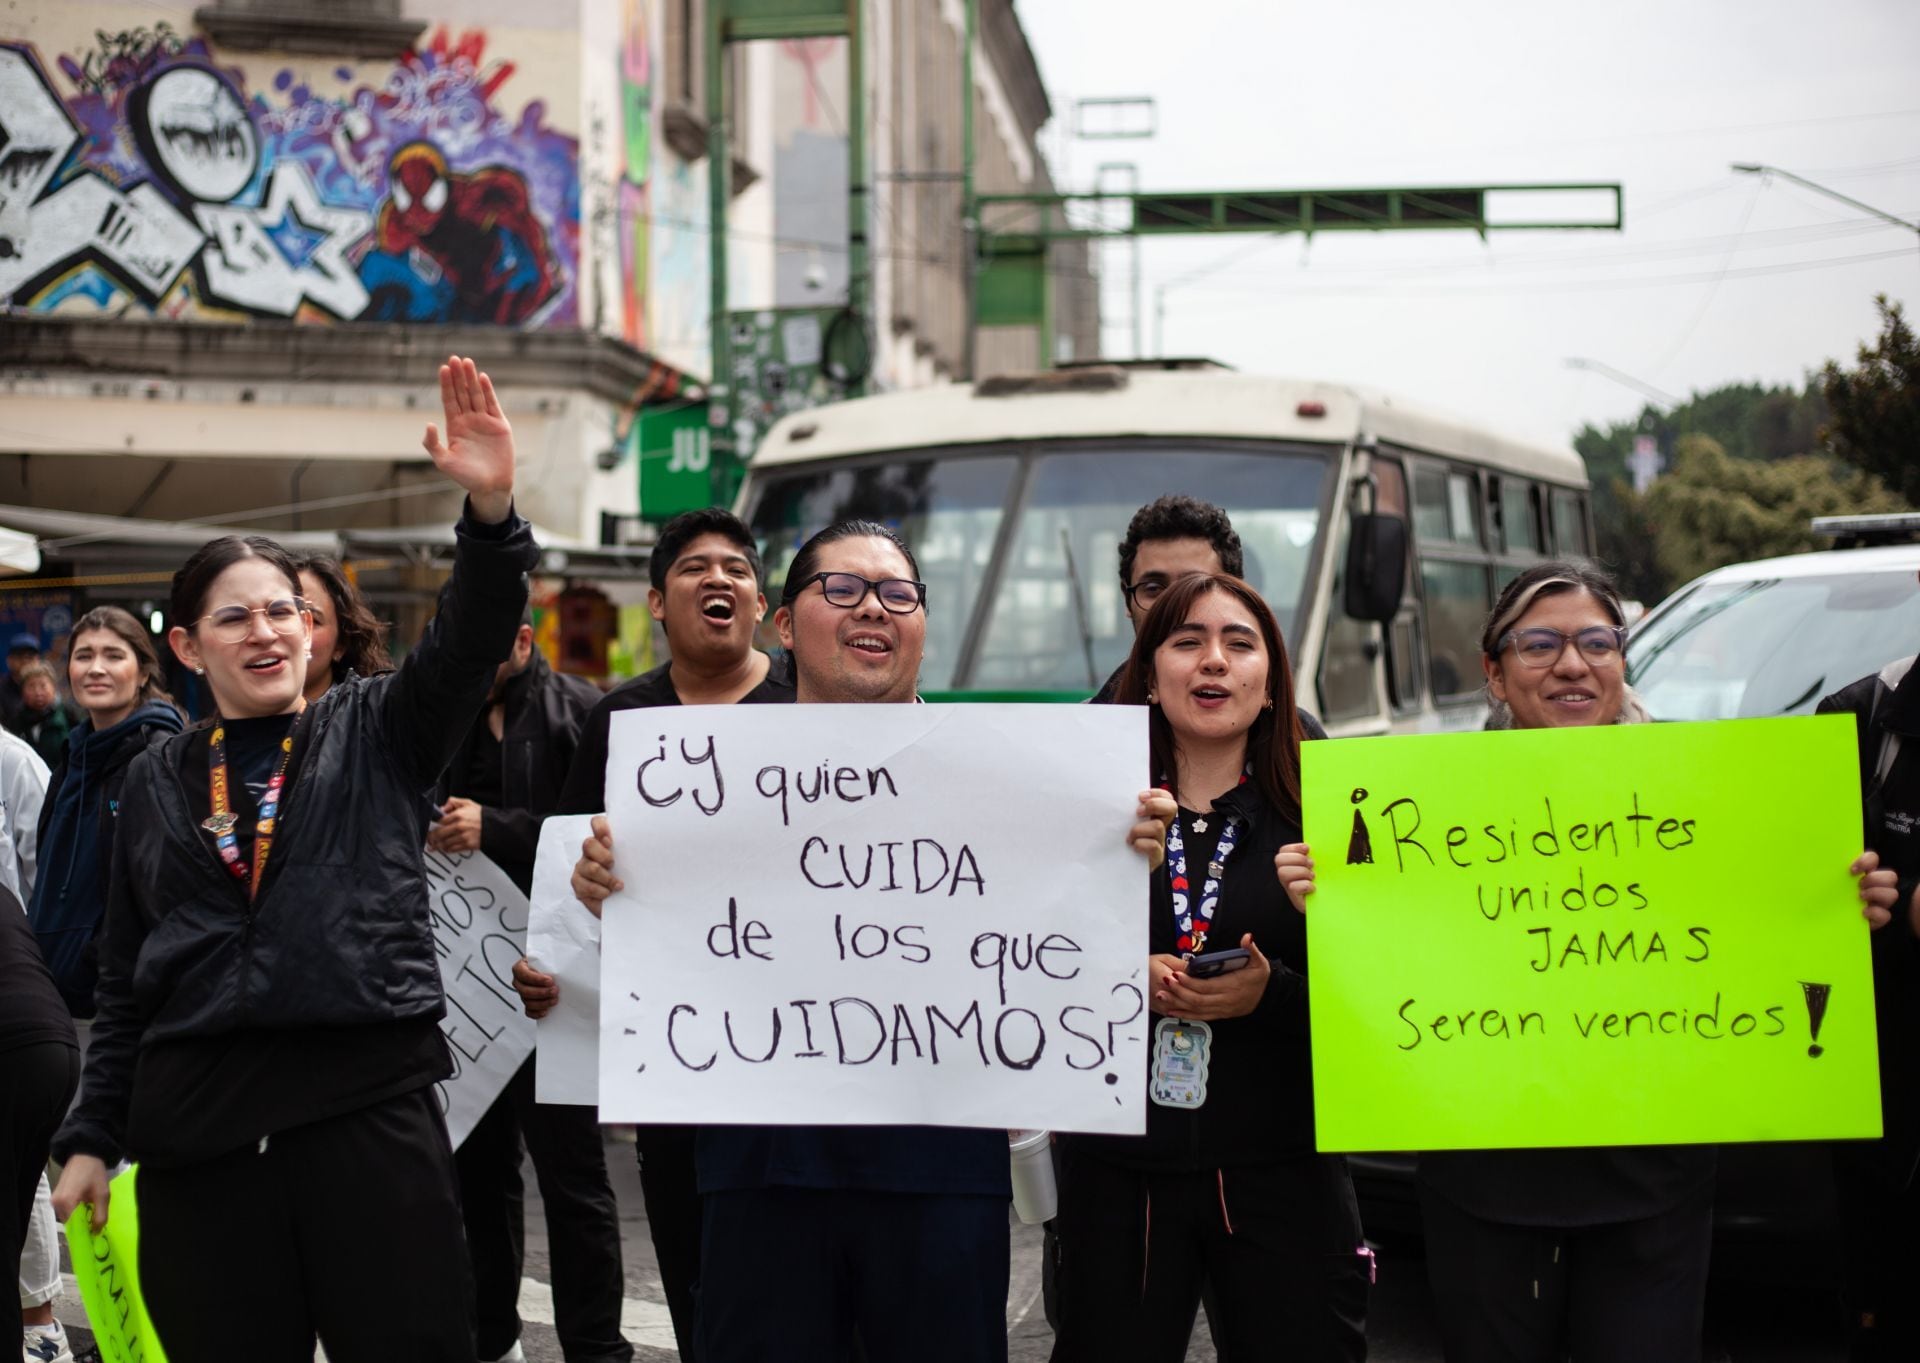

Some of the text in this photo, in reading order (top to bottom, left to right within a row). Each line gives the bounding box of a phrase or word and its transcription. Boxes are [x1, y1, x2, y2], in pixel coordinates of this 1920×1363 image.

[755, 760, 899, 826] quien
[799, 836, 985, 897] CUIDA
[1477, 866, 1649, 921] unidos
[430, 874, 496, 959] MOS
[1527, 926, 1711, 973] JAMAS
[706, 896, 1083, 1006] de los que
[667, 983, 1144, 1086] CUIDAMOS?
